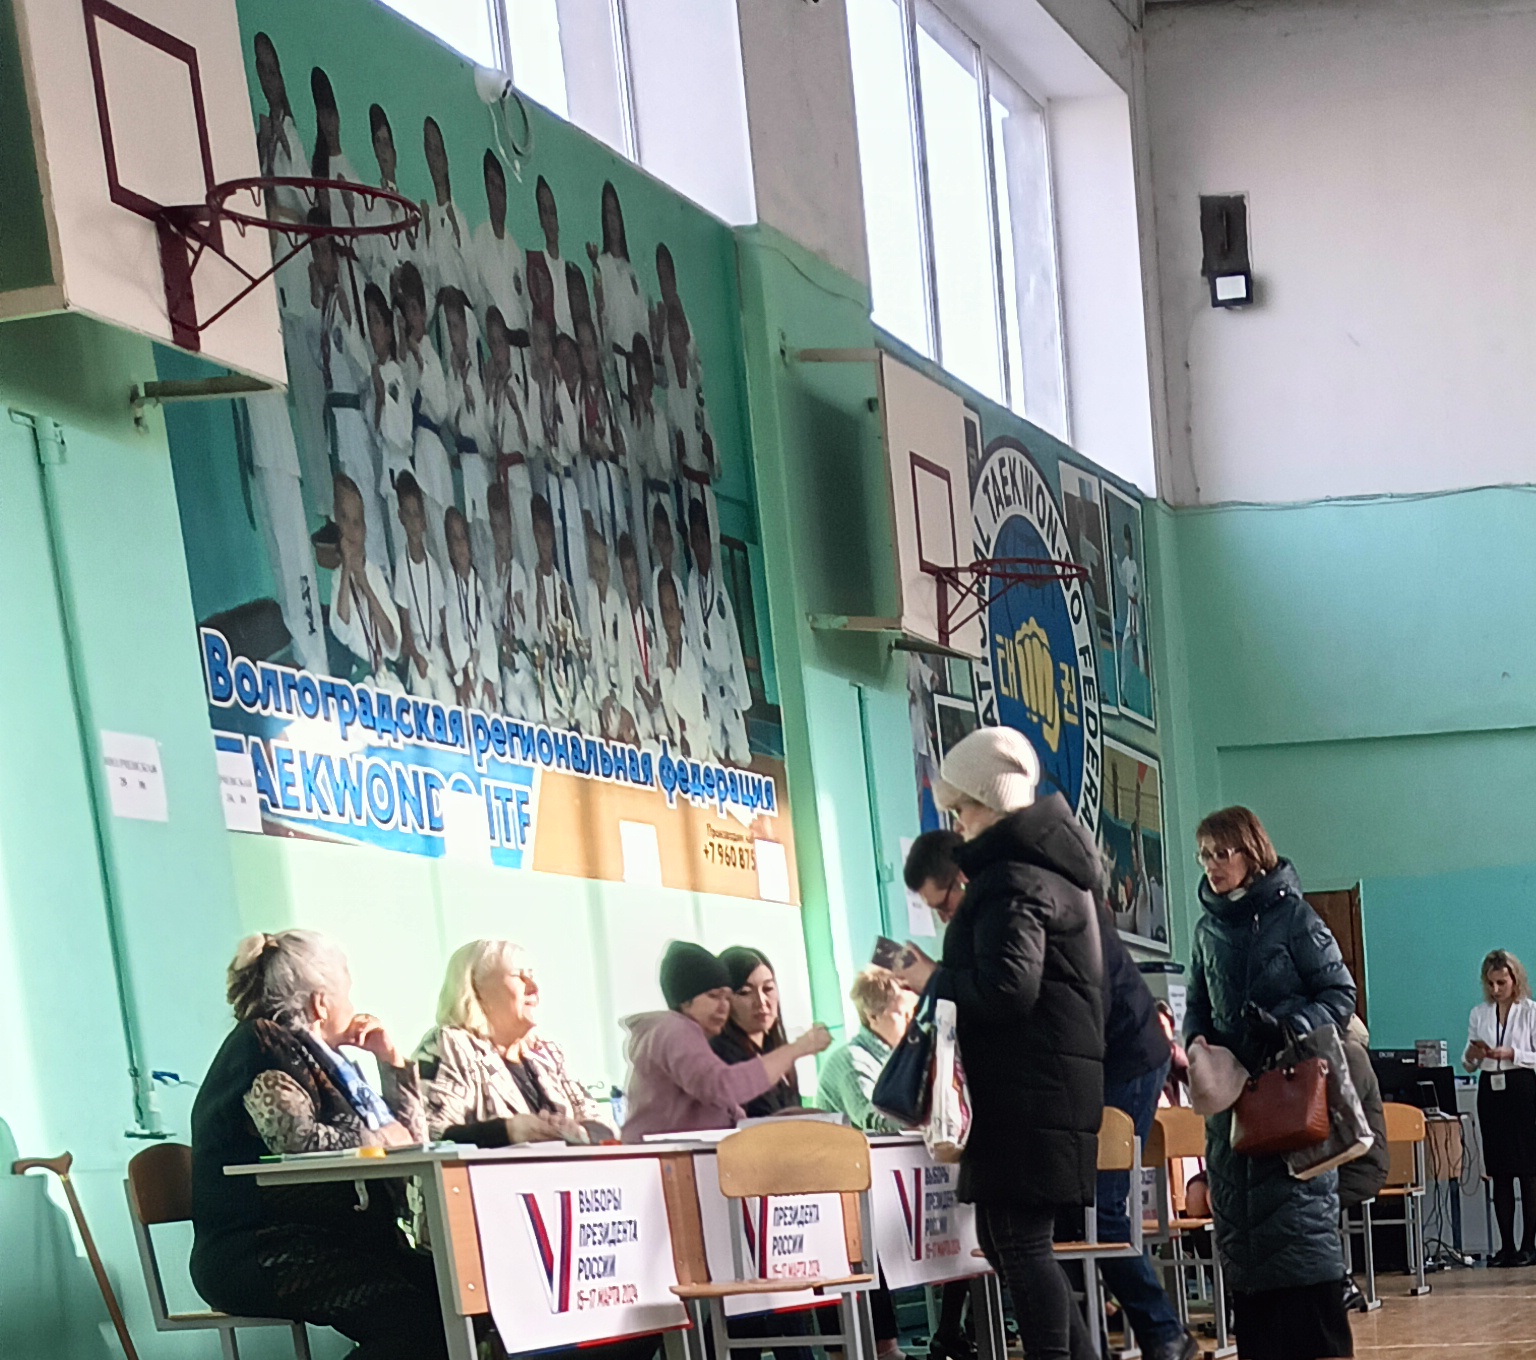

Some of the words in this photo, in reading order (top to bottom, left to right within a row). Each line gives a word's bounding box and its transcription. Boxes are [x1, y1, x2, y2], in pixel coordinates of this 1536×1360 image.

[203, 632, 466, 750] Волгоградская
[474, 718, 654, 785] региональная
[658, 746, 776, 814] федерация
[213, 734, 473, 833] AEKWOND
[483, 783, 532, 847] ITF
[578, 1188, 622, 1213] ВЫБОРЫ
[773, 1204, 820, 1227] ПРЕЗИДЕНТА
[579, 1219, 638, 1247] ПРЕЗИДЕНТА
[772, 1234, 804, 1257] РОССИИ
[578, 1255, 616, 1281] РОССИИ
